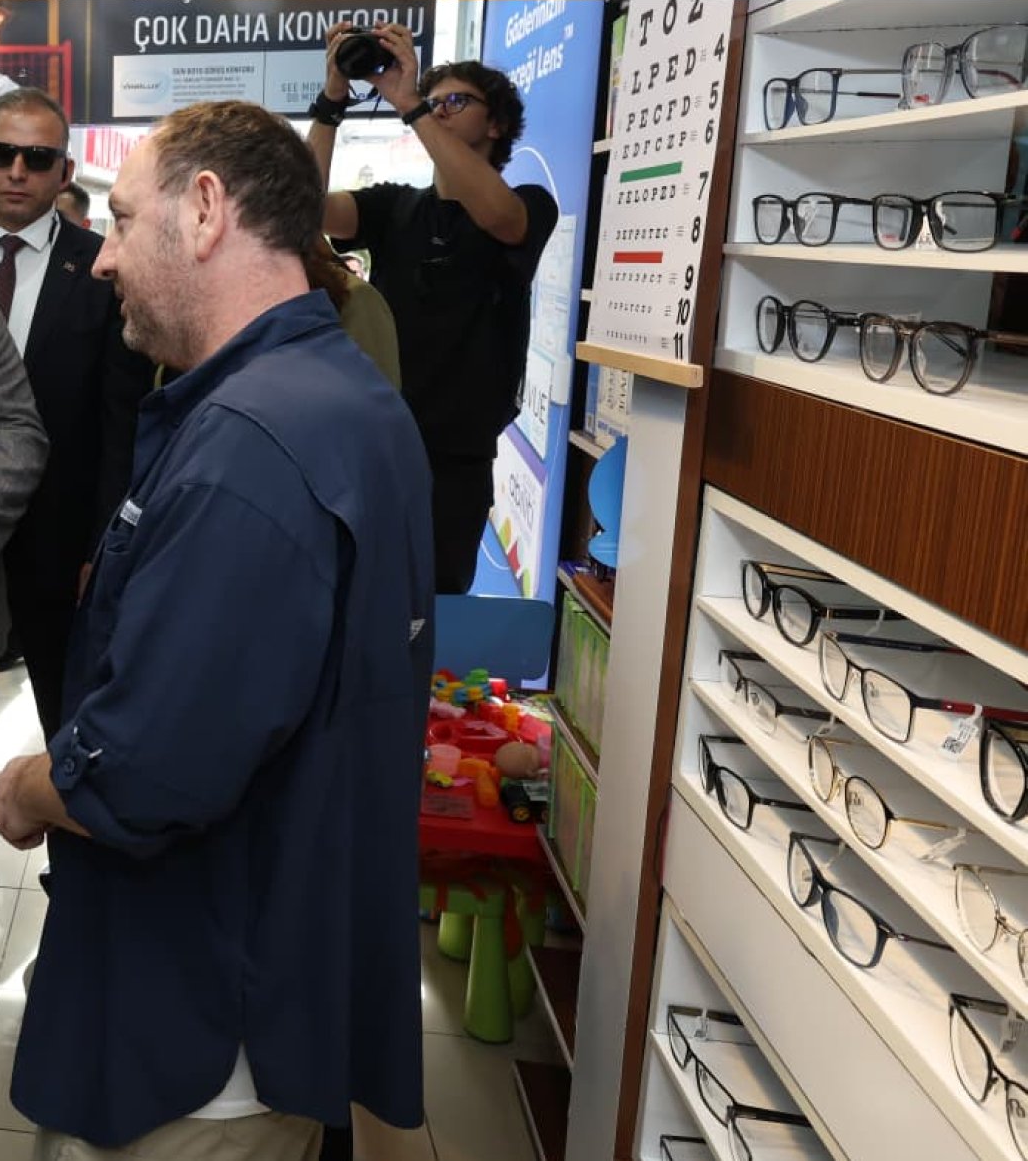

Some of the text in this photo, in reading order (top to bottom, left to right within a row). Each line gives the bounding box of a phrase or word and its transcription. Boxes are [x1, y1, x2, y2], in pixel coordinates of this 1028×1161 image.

[134, 15, 187, 52] ÇOK
[196, 12, 270, 45] DAHA
[537, 45, 564, 78] Lens
[713, 32, 725, 62] 4
[708, 80, 719, 110] 5
[705, 118, 715, 144] 6
[697, 170, 709, 201] 7
[691, 215, 701, 243] 8
[684, 265, 694, 291] 9
[676, 297, 690, 326] 10
[673, 333, 684, 360] 11
